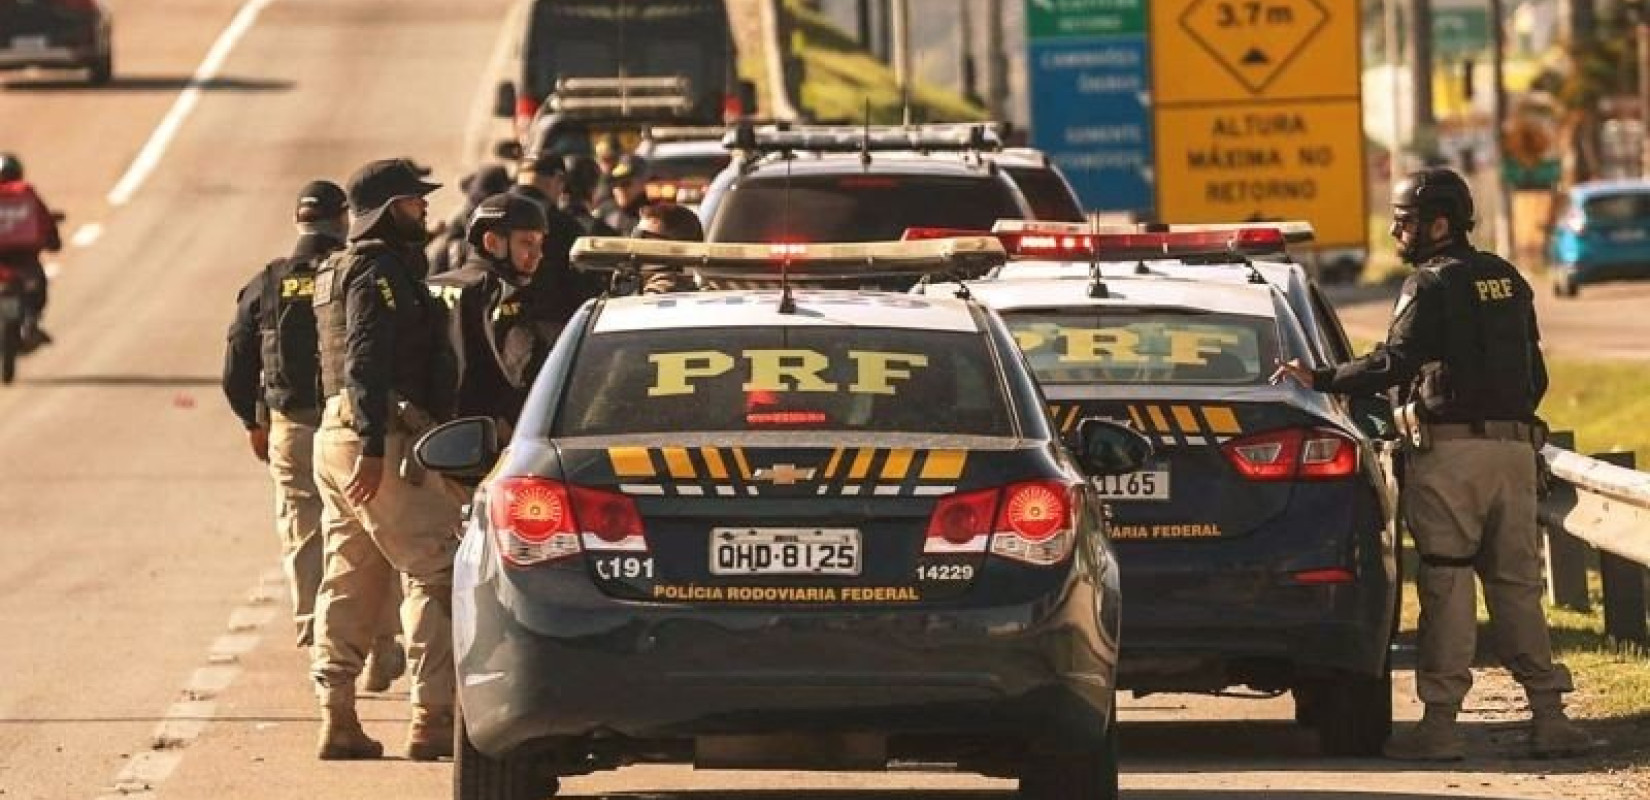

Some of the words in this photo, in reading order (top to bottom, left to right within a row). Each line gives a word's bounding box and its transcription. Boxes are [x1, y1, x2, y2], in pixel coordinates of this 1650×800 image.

[1212, 114, 1308, 136] ALTURA
[1299, 147, 1334, 167] NO
[1206, 179, 1319, 202] RETORNO
[1475, 278, 1513, 301] PRF
[647, 350, 929, 397] PRF
[1152, 523, 1222, 538] FEDERAL
[610, 557, 655, 578] 191
[917, 564, 974, 581] 14229
[653, 583, 723, 600] POLÍCIA
[727, 586, 836, 601] RODOVIARIA
[840, 586, 919, 601] FEDERAL
